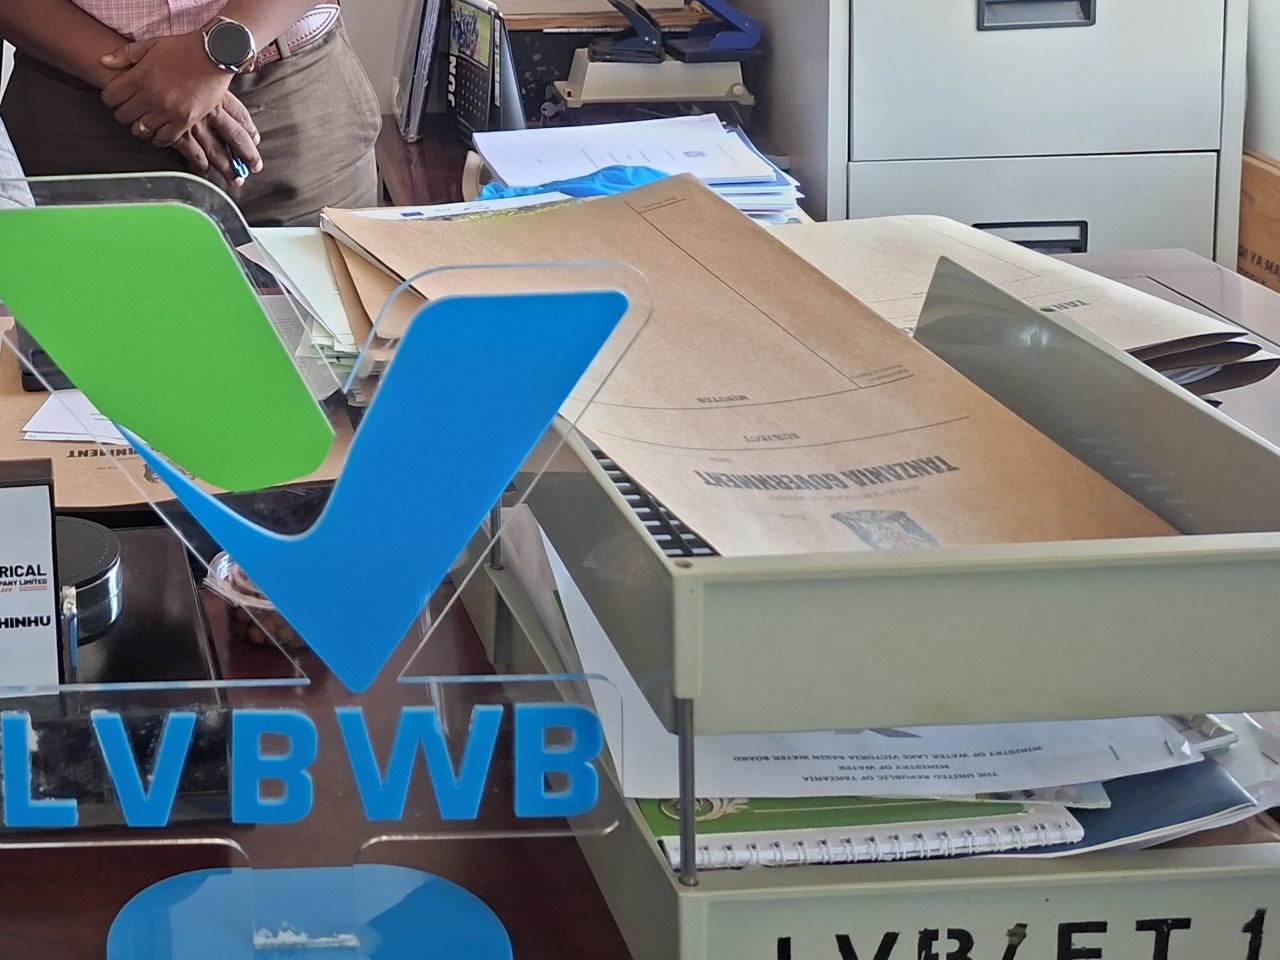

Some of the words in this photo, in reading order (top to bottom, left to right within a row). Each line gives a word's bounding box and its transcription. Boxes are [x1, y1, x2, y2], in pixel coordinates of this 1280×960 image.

[448, 56, 457, 107] JUN
[693, 469, 849, 490] GOVERNMENT
[841, 455, 960, 487] TANZANIA
[0, 702, 604, 828] LVBWB
